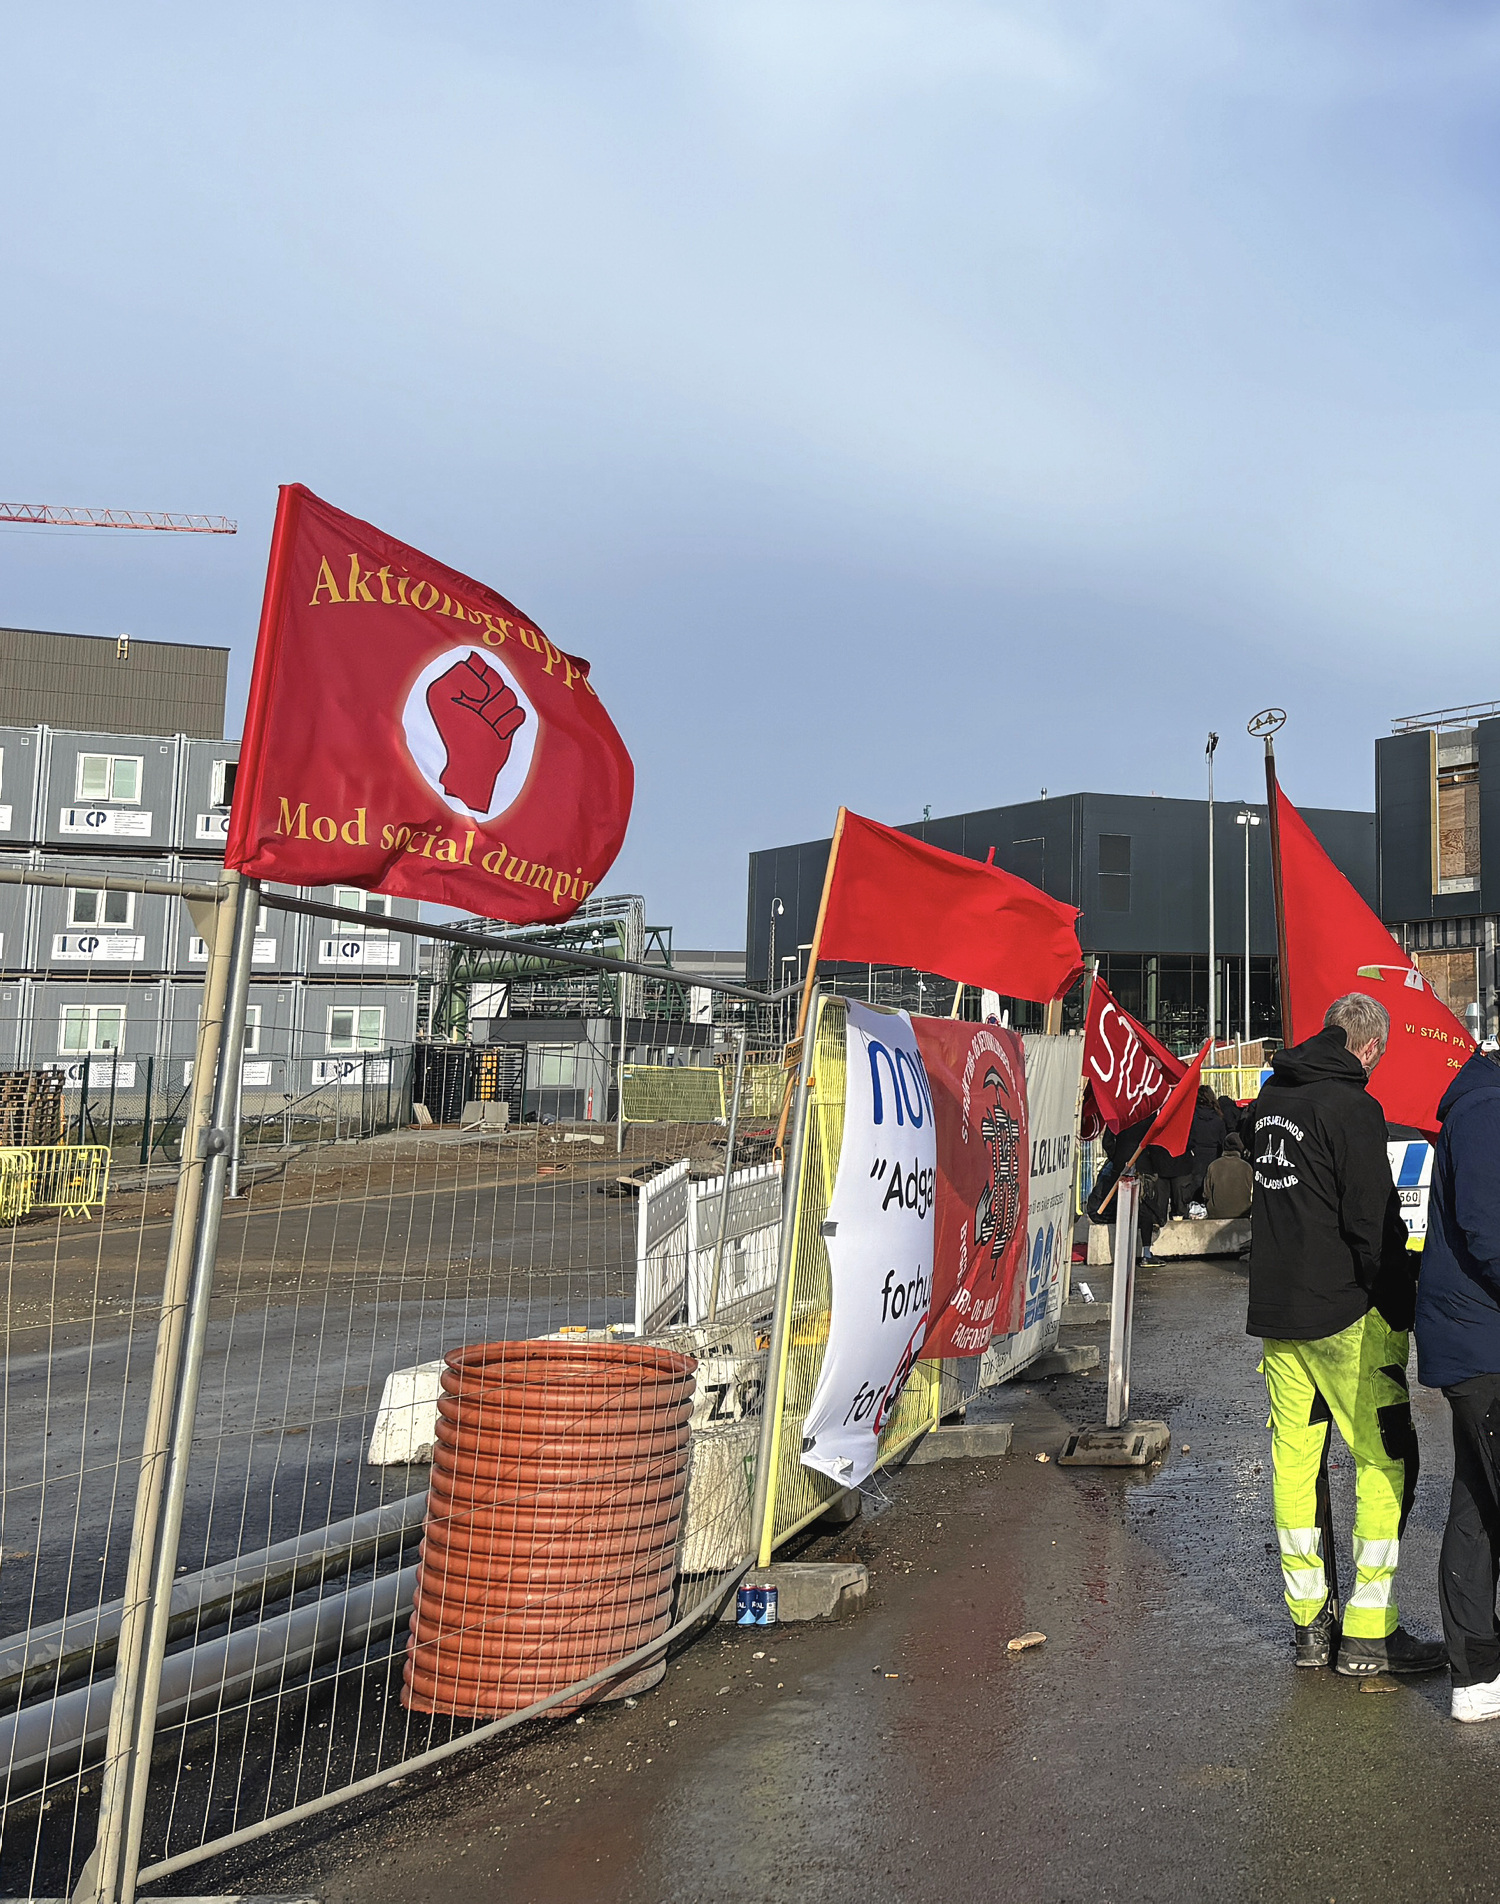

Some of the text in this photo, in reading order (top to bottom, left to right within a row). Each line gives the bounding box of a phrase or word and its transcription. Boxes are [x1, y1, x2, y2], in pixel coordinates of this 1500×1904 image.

[274, 797, 369, 847] Mod
[380, 825, 476, 867] social
[1405, 1024, 1415, 1034] VI
[1420, 1027, 1448, 1043] STÅR
[1452, 1036, 1466, 1049] PÅ
